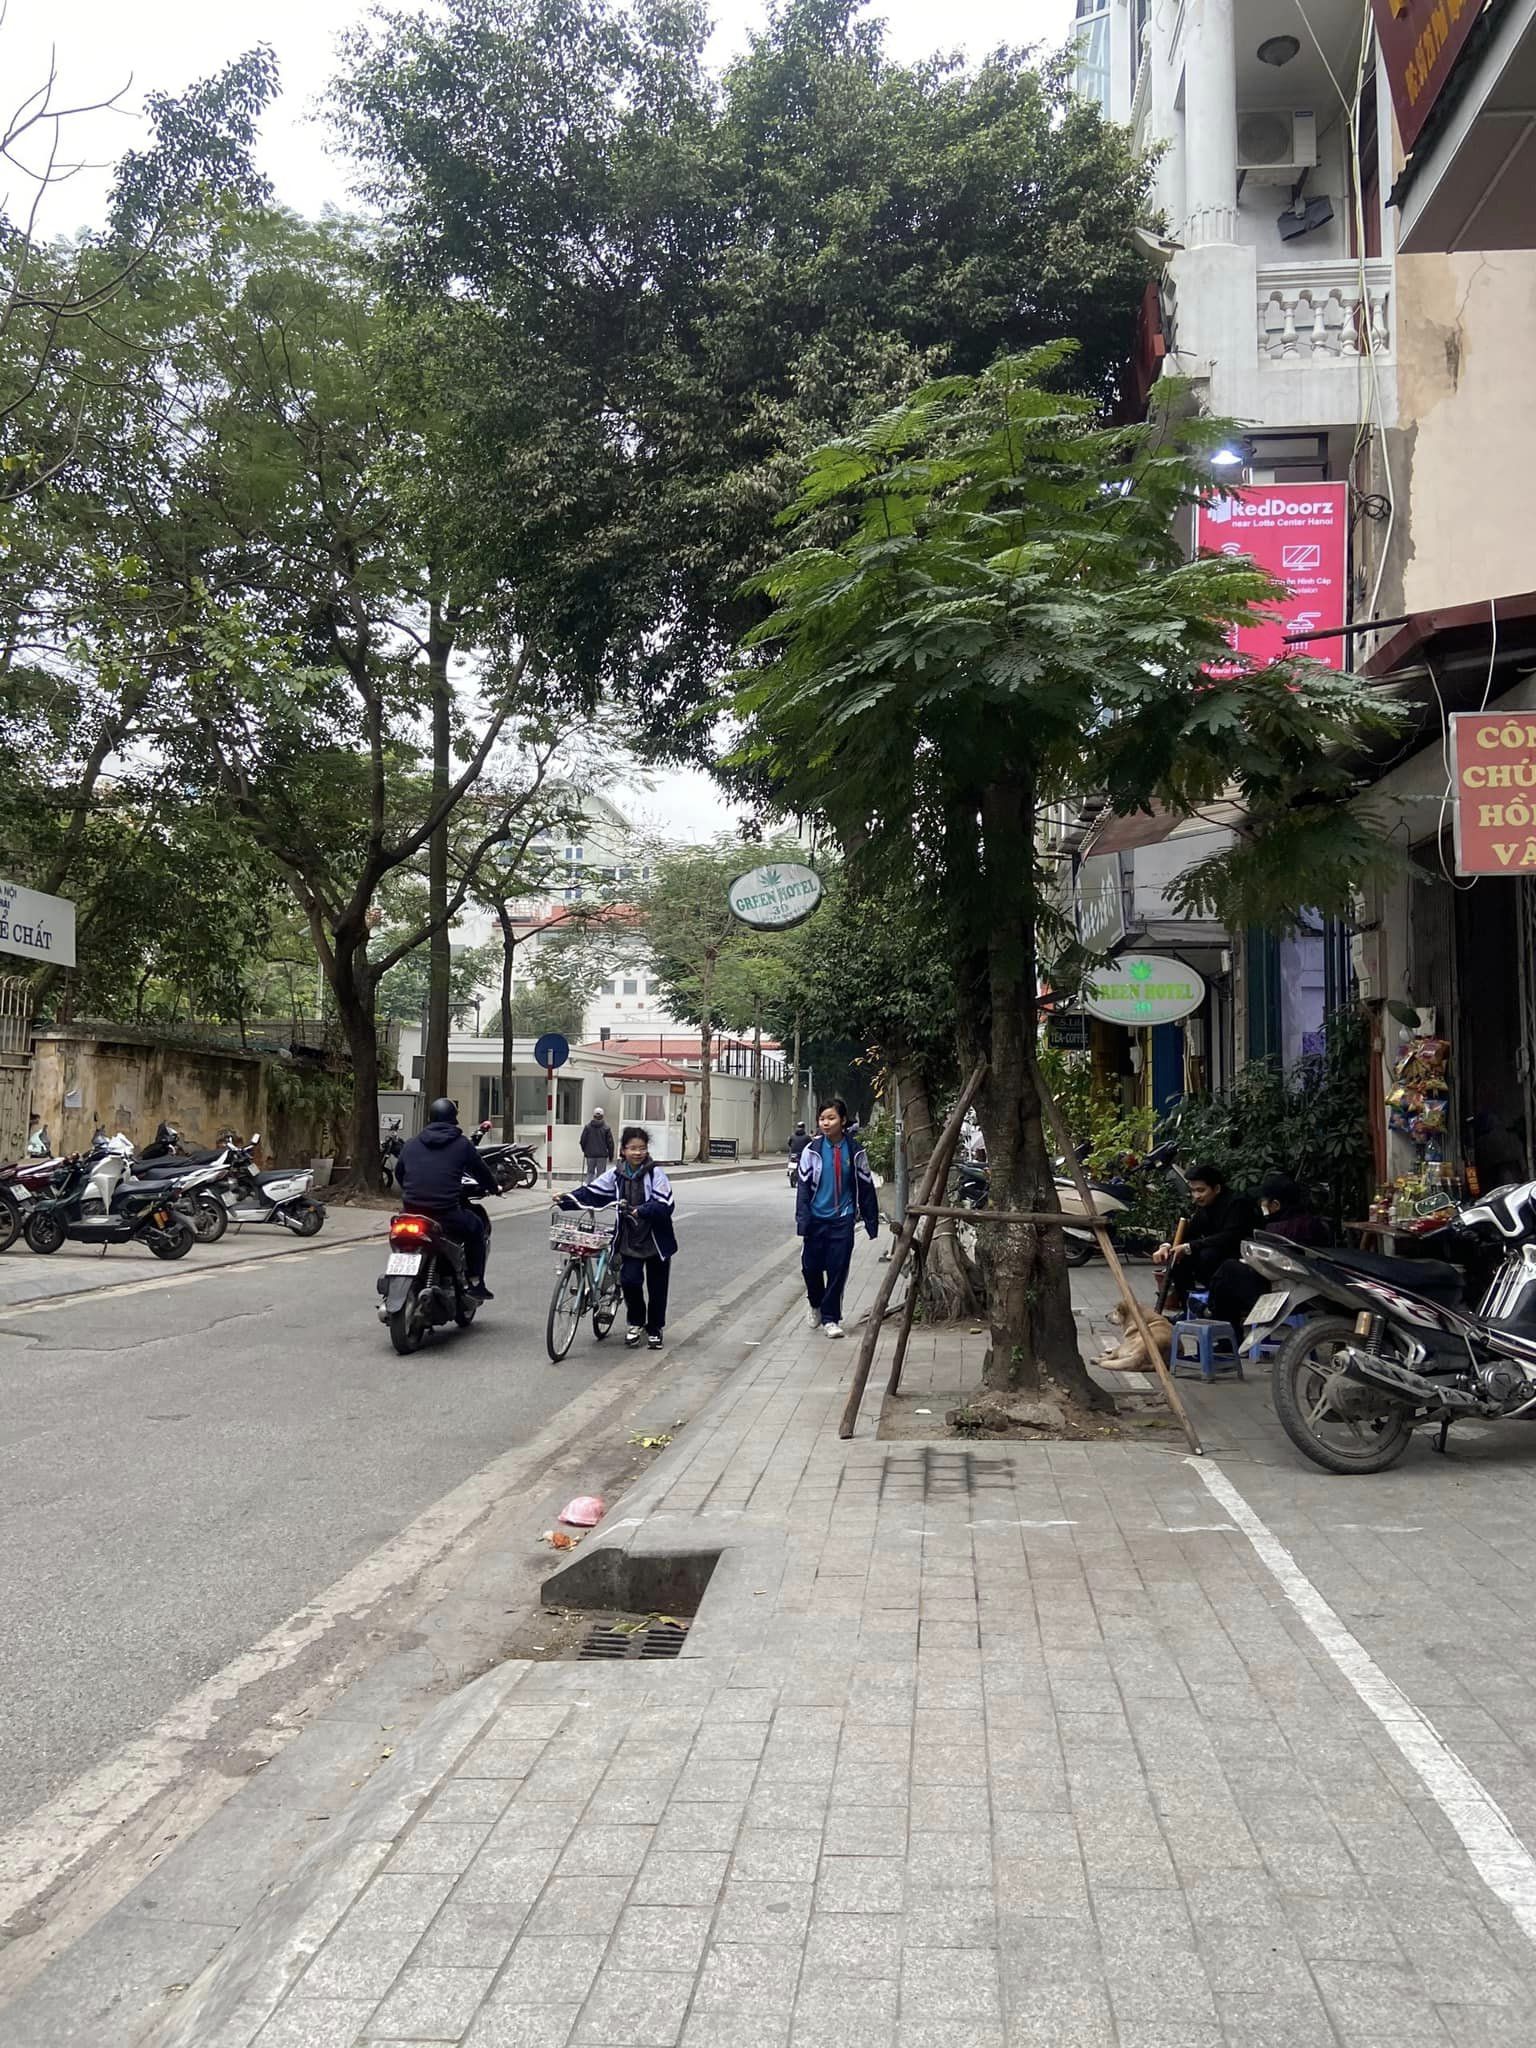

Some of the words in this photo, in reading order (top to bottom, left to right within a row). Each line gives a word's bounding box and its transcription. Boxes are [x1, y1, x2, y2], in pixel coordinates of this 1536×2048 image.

[1231, 499, 1334, 517] RedDoorz
[1232, 520, 1251, 528] near
[1253, 519, 1275, 528] Lotte
[1277, 518, 1306, 527] Center
[1308, 517, 1334, 526] Hanoi
[1478, 792, 1536, 828] HỒ
[735, 889, 777, 912] GREEN
[777, 879, 817, 903] HOTEL
[13, 920, 52, 950] CHẤT
[1092, 983, 1140, 999] REEN
[1144, 983, 1194, 999] HOTEL
